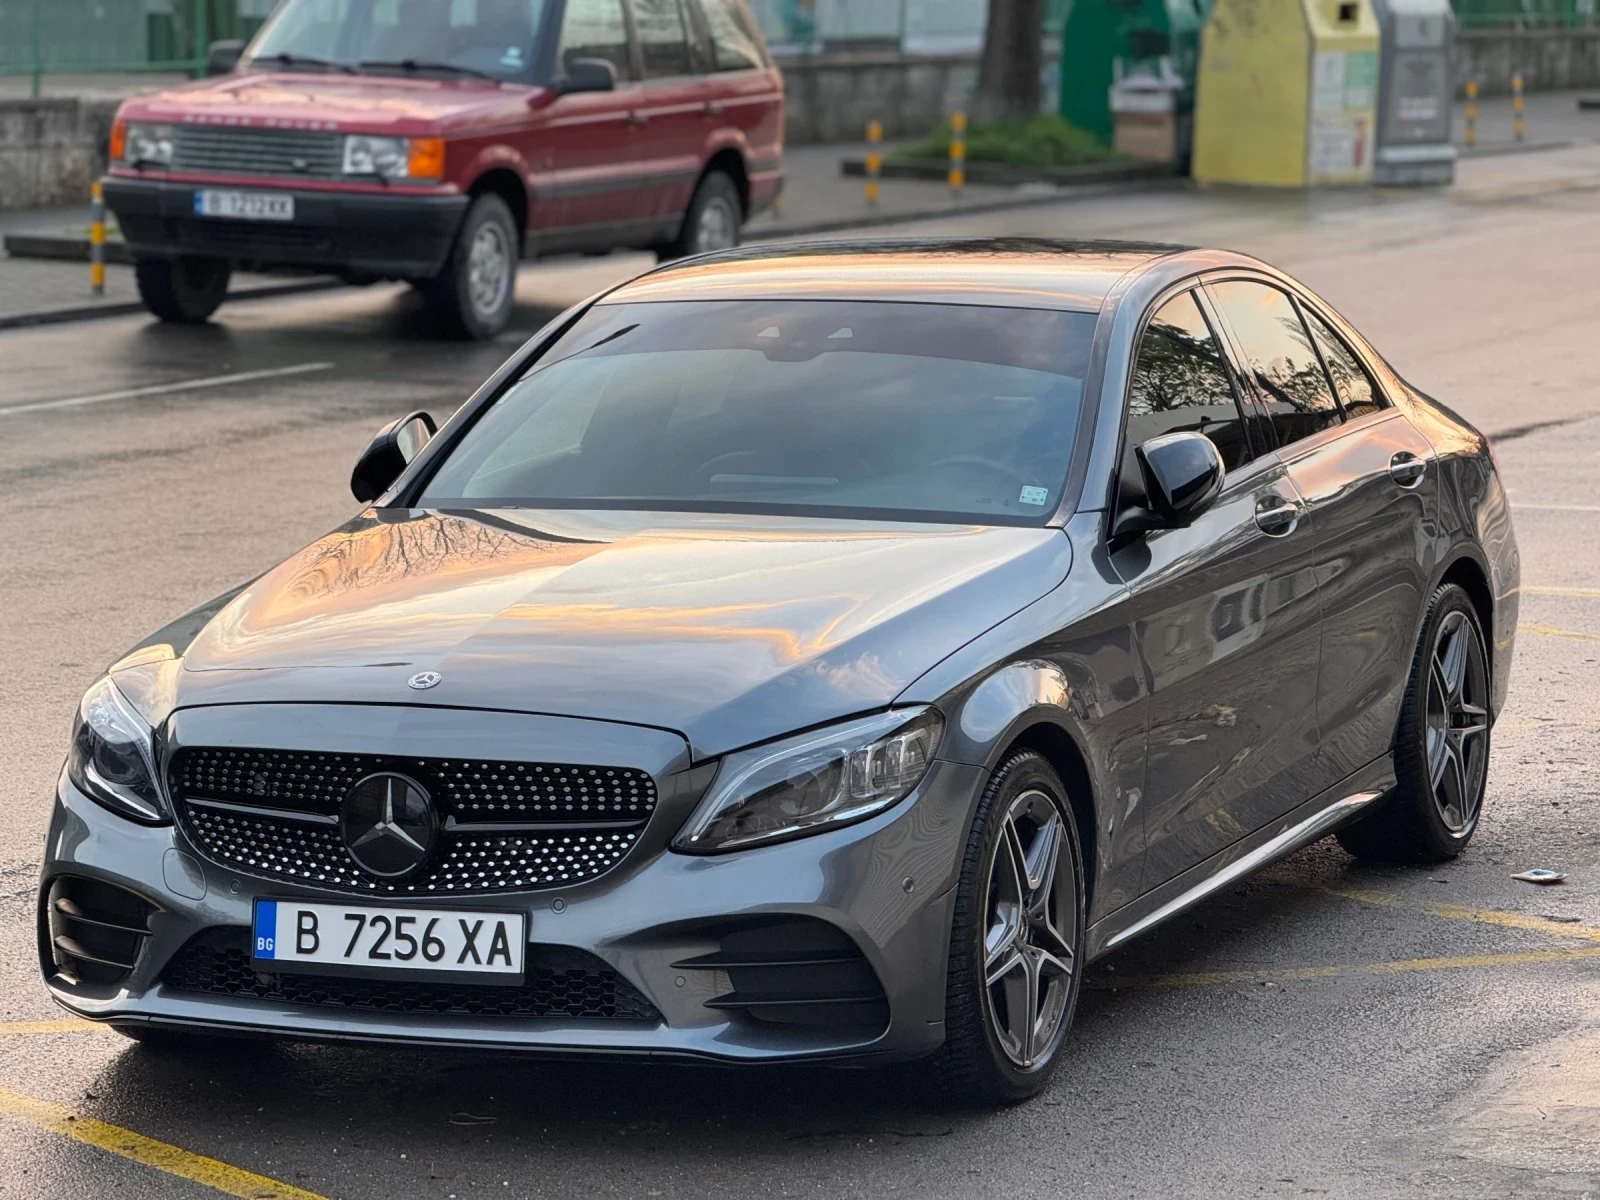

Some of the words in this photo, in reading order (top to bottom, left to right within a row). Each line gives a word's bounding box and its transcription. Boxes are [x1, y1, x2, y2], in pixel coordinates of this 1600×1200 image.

[257, 937, 274, 951] BG
[296, 910, 320, 954] B
[343, 913, 446, 962] 7256
[456, 919, 513, 966] XA
